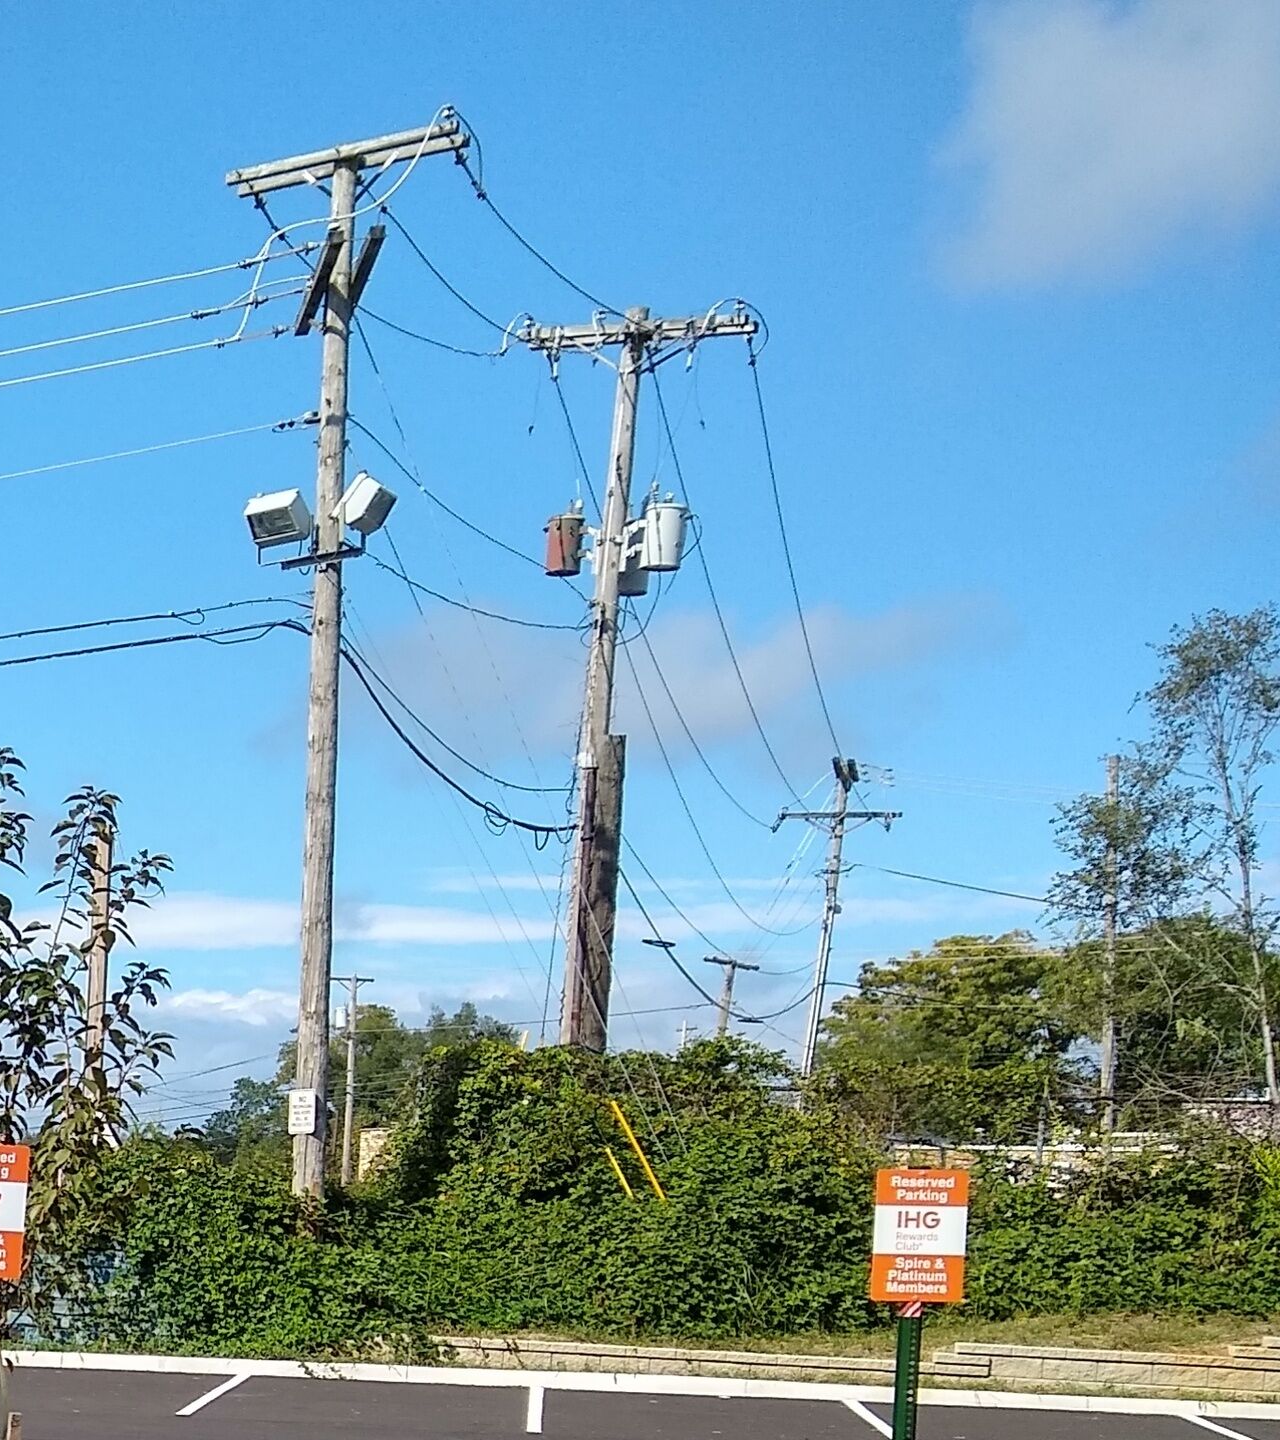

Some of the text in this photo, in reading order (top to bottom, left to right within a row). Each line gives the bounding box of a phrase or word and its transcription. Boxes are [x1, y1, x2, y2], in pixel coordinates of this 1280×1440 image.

[890, 1175, 955, 1188] Reserved
[896, 1189, 948, 1204] Parking
[897, 1211, 941, 1229] IHG
[896, 1231, 939, 1241] Rewards
[895, 1257, 945, 1270] Spire &
[887, 1269, 947, 1282] Platinum
[886, 1281, 948, 1294] Members
